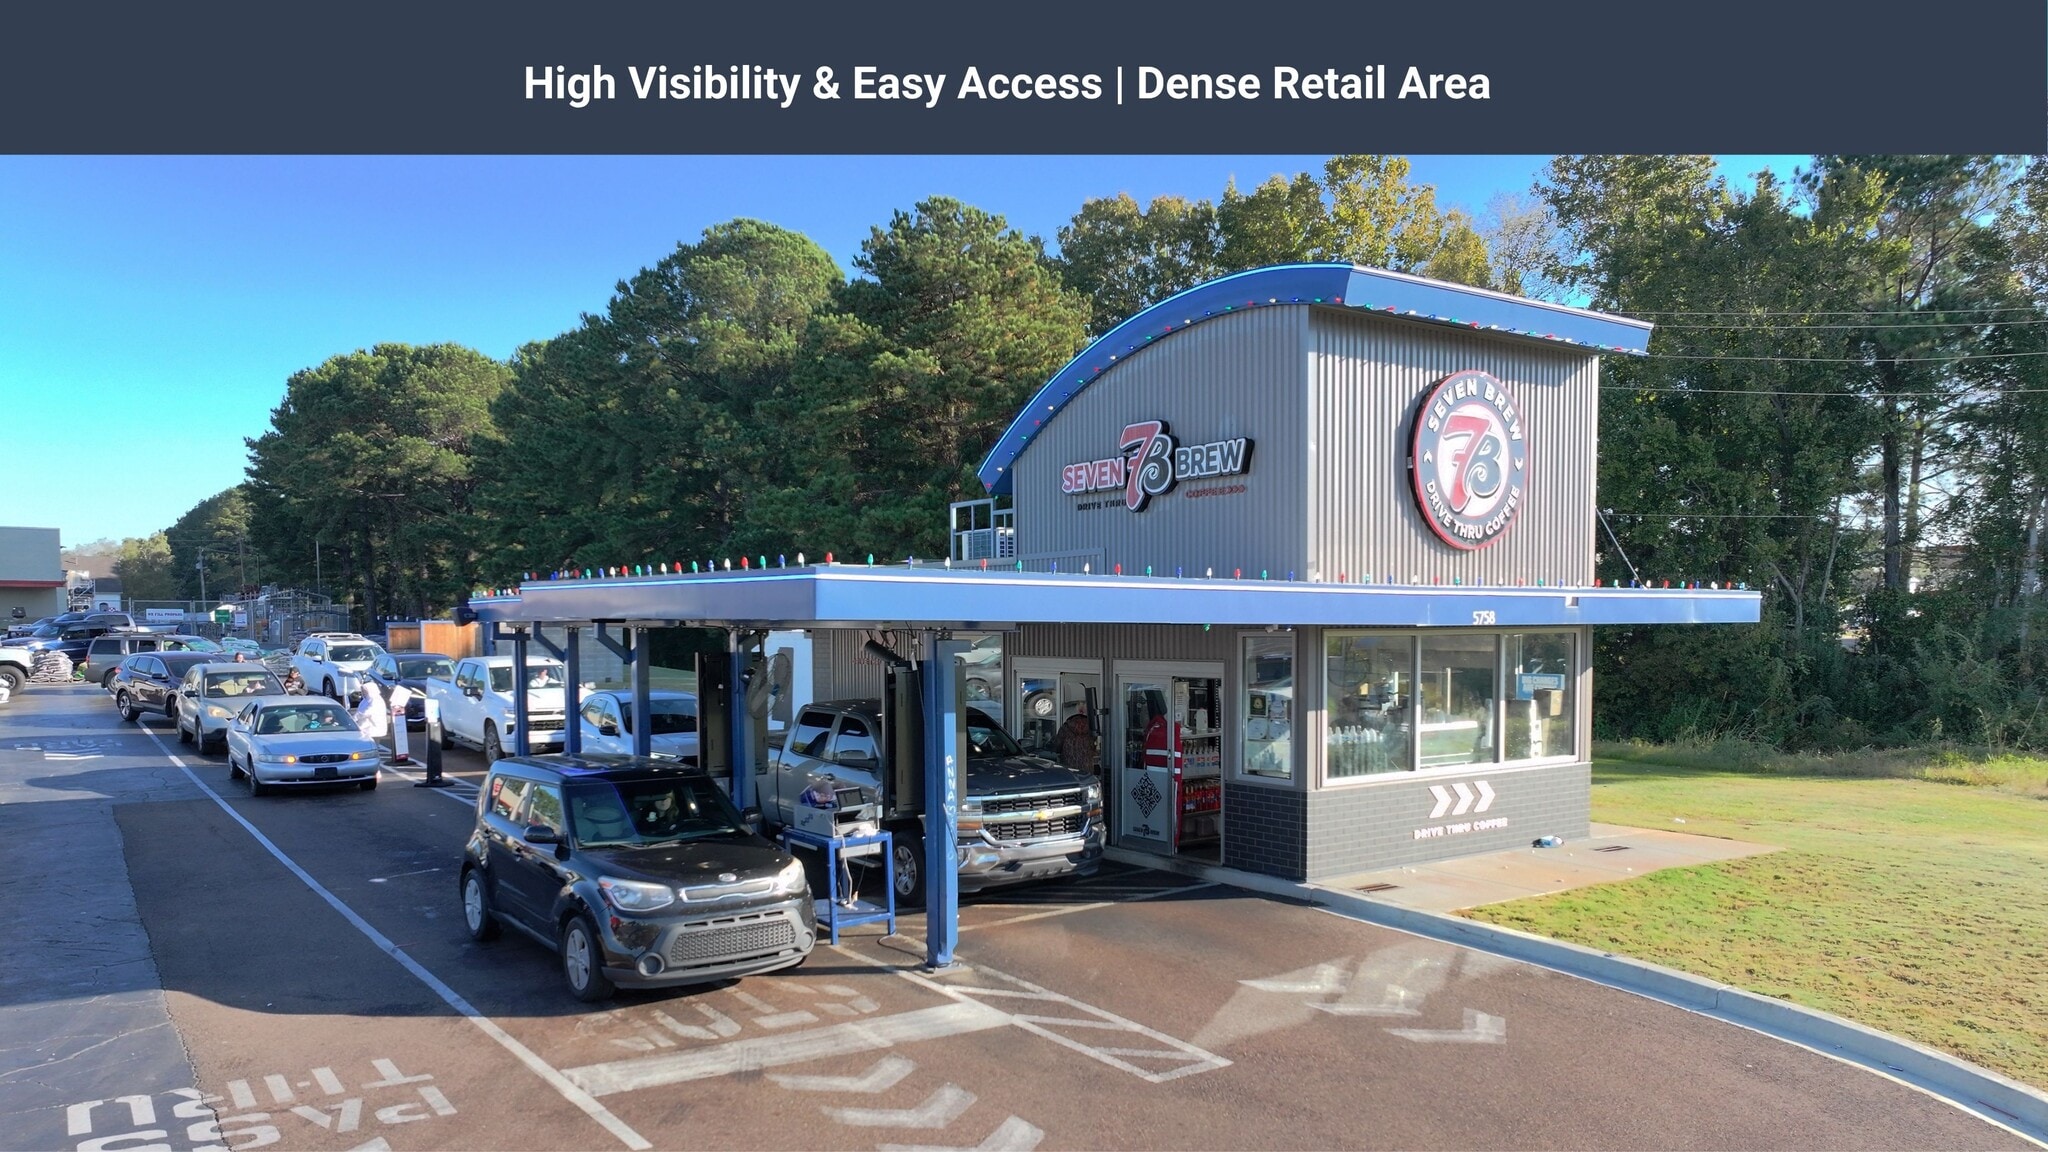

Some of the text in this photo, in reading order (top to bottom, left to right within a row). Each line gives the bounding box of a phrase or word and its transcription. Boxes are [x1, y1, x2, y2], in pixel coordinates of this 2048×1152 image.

[1428, 378, 1522, 441] SEVEN BREW
[1062, 457, 1126, 494] SEVEN
[1175, 437, 1247, 480] BREW
[1077, 498, 1127, 512] DRIVE THRU
[1185, 486, 1226, 499] COFFEE
[1426, 479, 1520, 540] DRIVE THRU COFFEE
[1472, 610, 1496, 625] 5758
[1413, 817, 1508, 840] DRIVE THRU COFFEE
[66, 1058, 435, 1137] THRU
